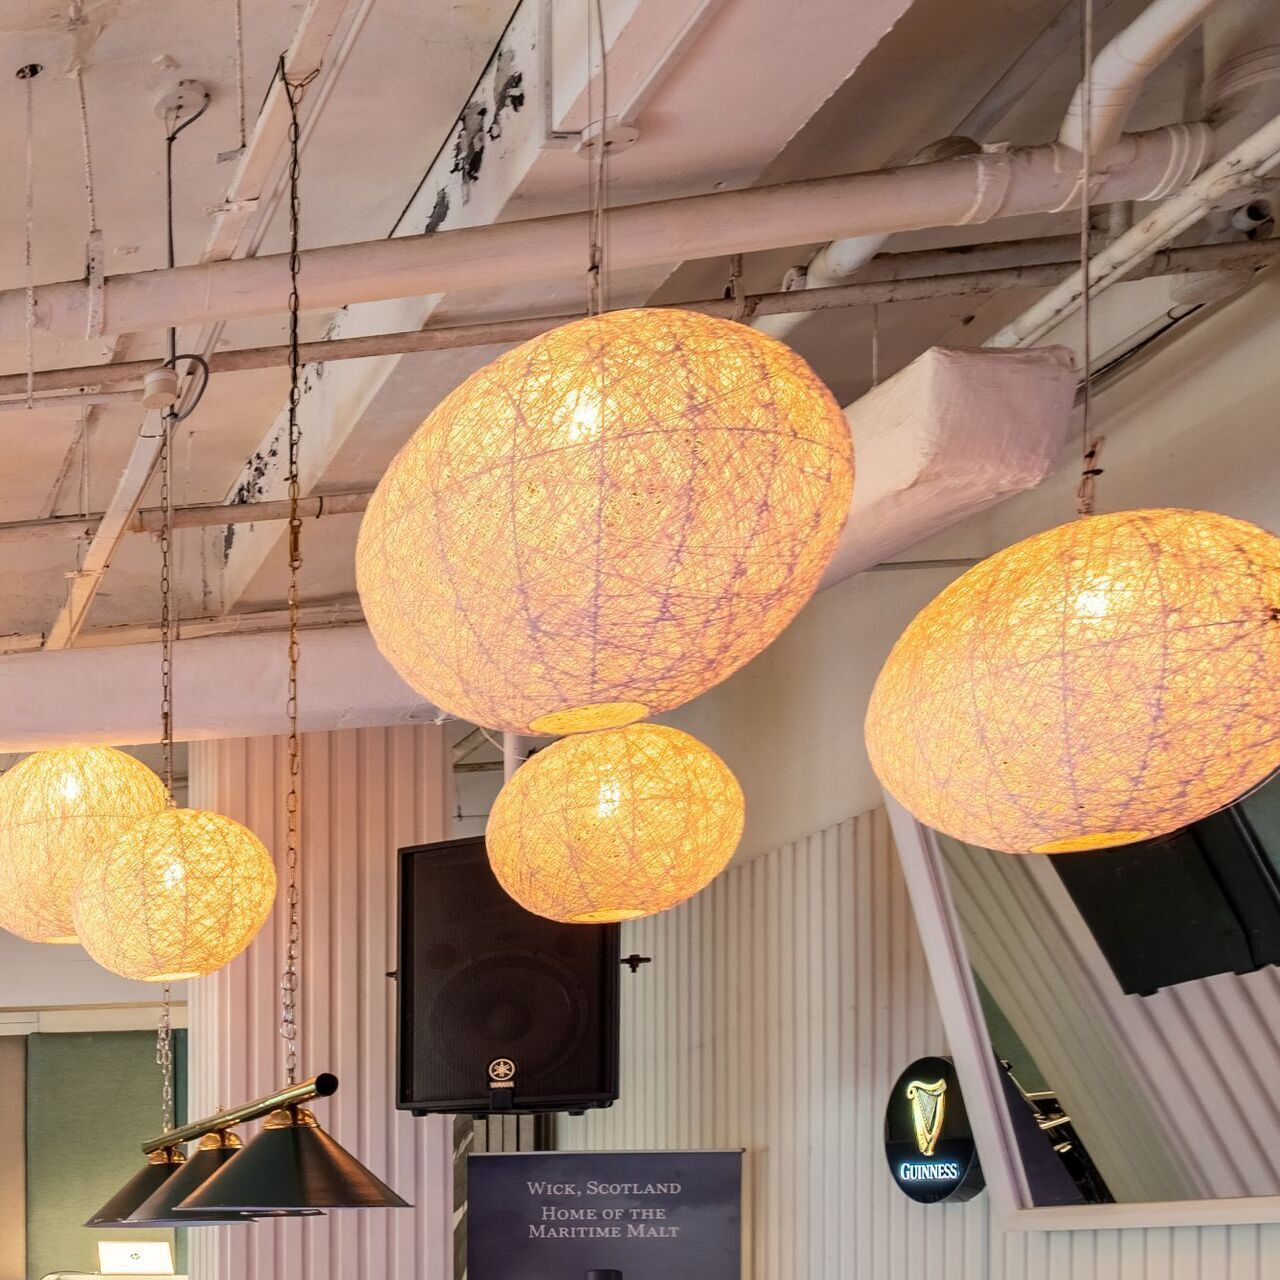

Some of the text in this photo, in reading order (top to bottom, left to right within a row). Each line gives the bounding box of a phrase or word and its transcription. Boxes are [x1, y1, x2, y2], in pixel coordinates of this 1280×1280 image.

[900, 1162, 957, 1180] GUINNESS
[586, 1180, 682, 1195] SCOTLAND
[541, 1206, 666, 1220] HOME OF THE
[528, 1223, 680, 1238] MARITIME MALT
